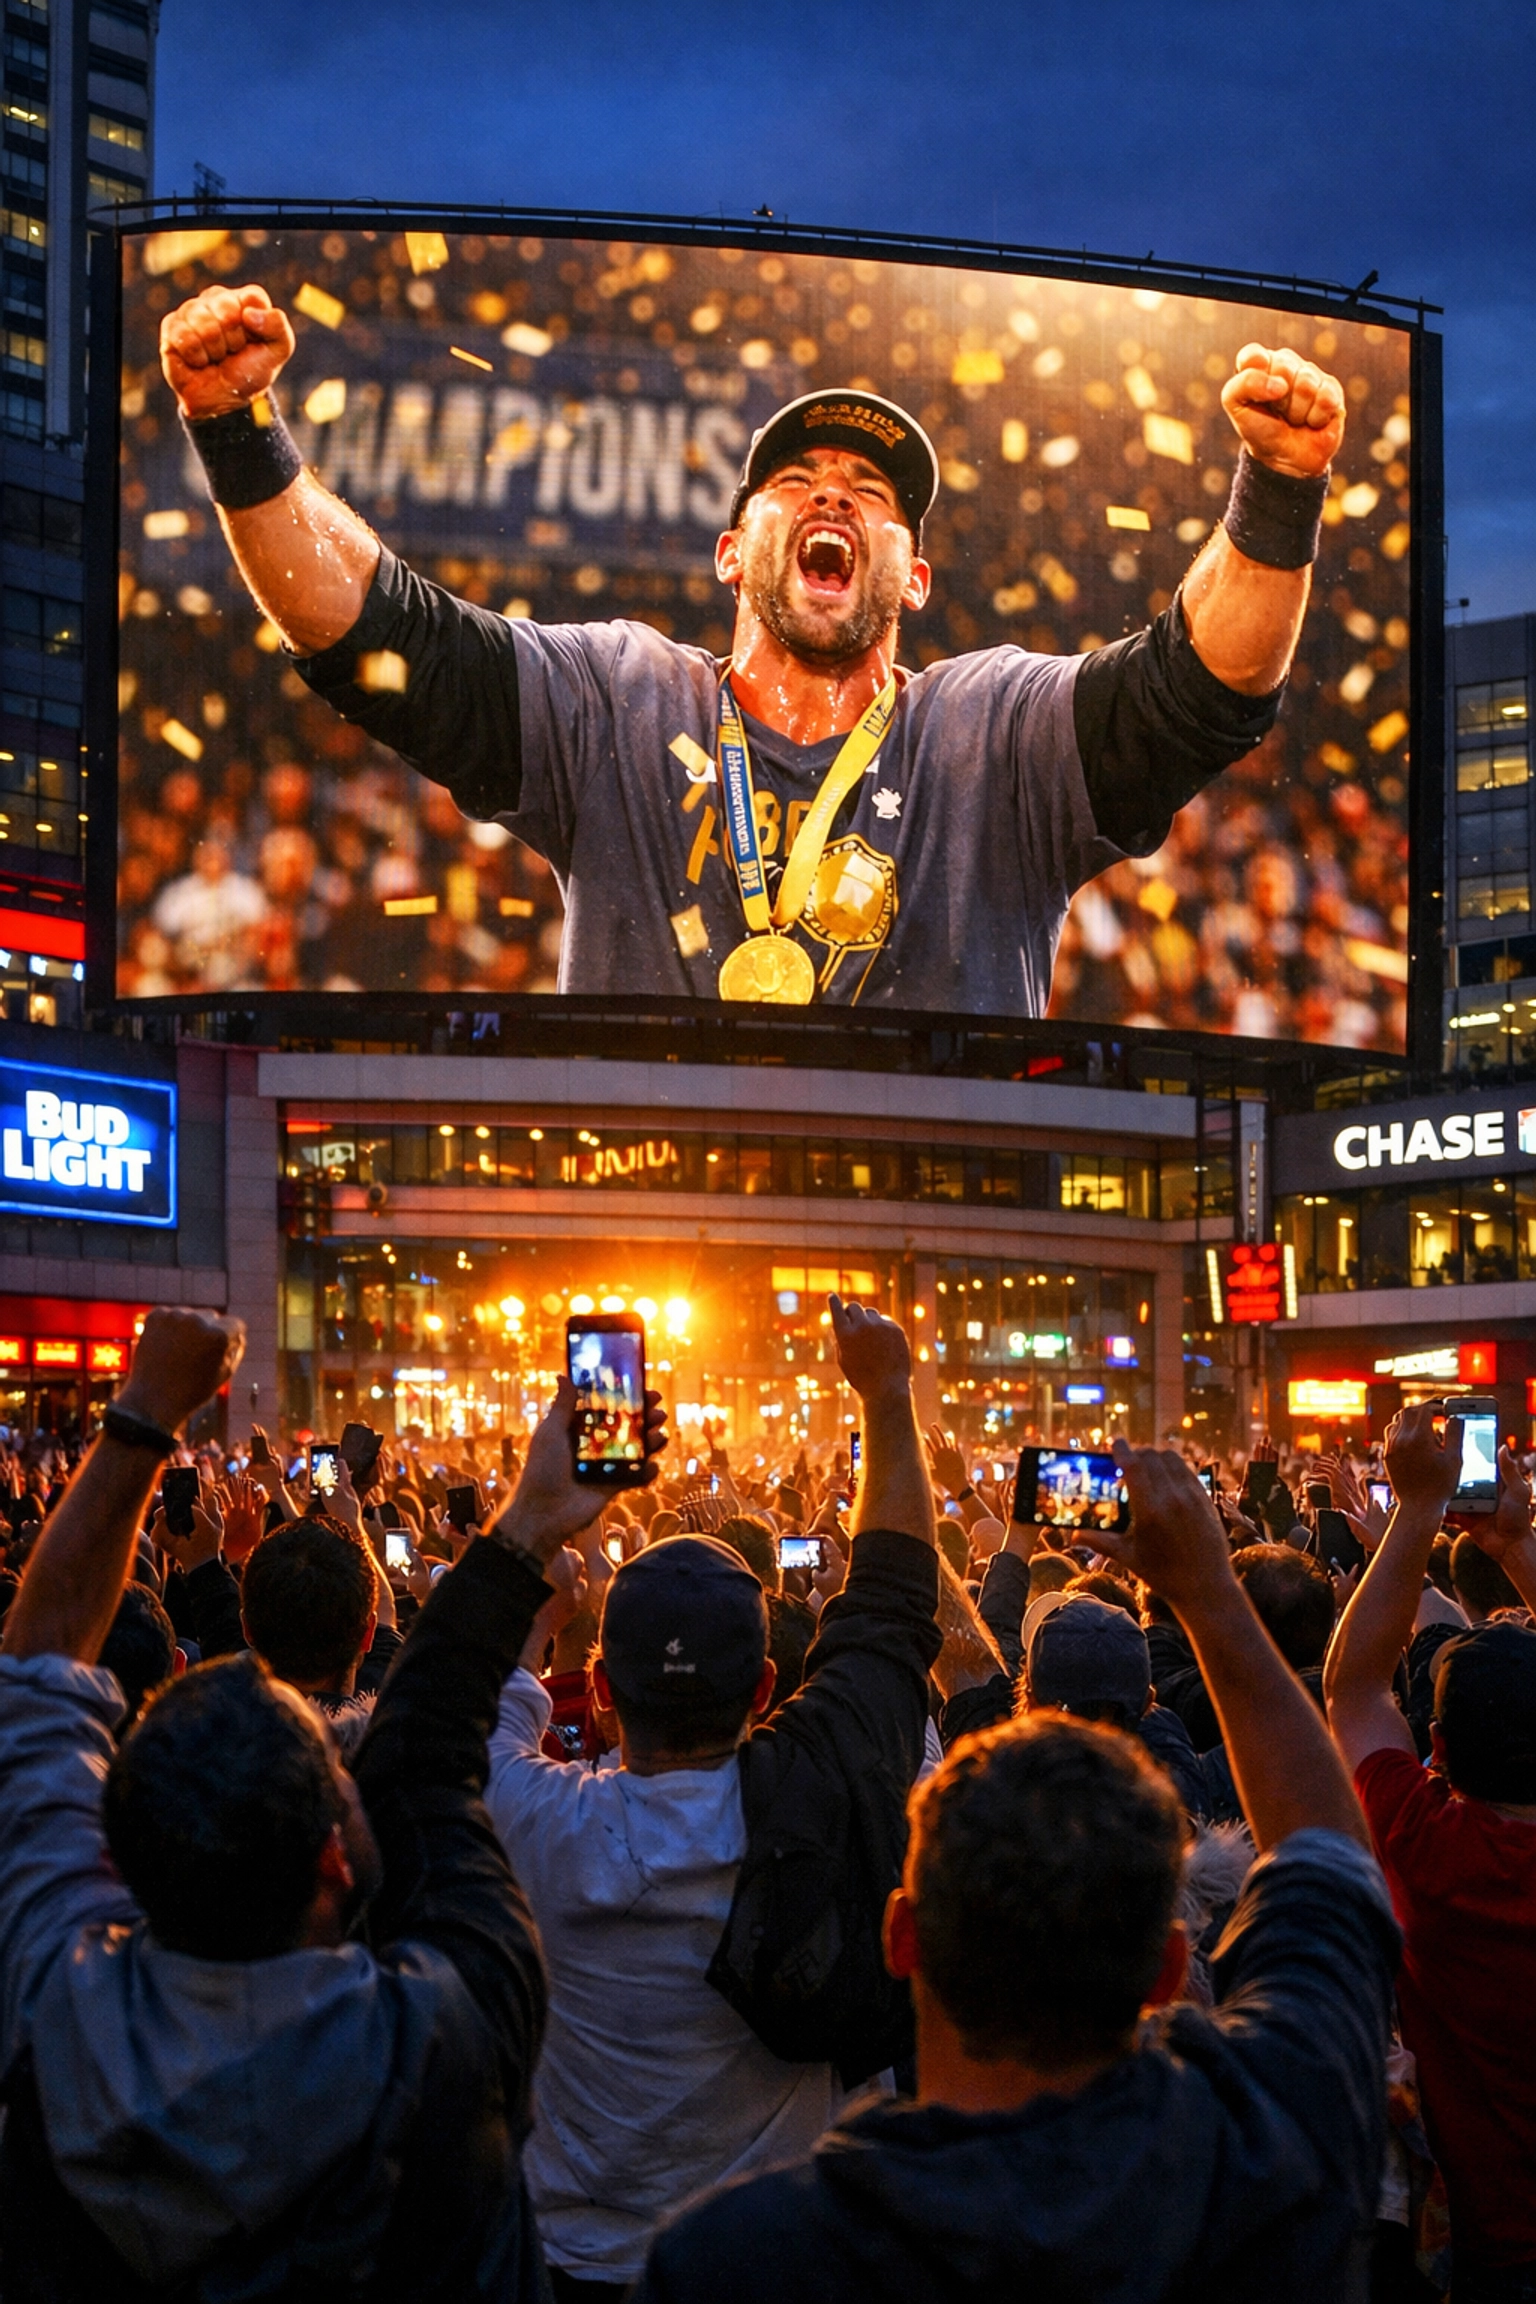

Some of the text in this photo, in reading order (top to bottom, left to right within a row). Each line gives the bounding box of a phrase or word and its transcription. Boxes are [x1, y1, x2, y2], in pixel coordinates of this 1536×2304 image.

[182, 376, 748, 527] AMPIONS
[26, 1090, 130, 1146] BUD
[1333, 1111, 1505, 1170] CHASE
[3, 1128, 152, 1192] LIGHT
